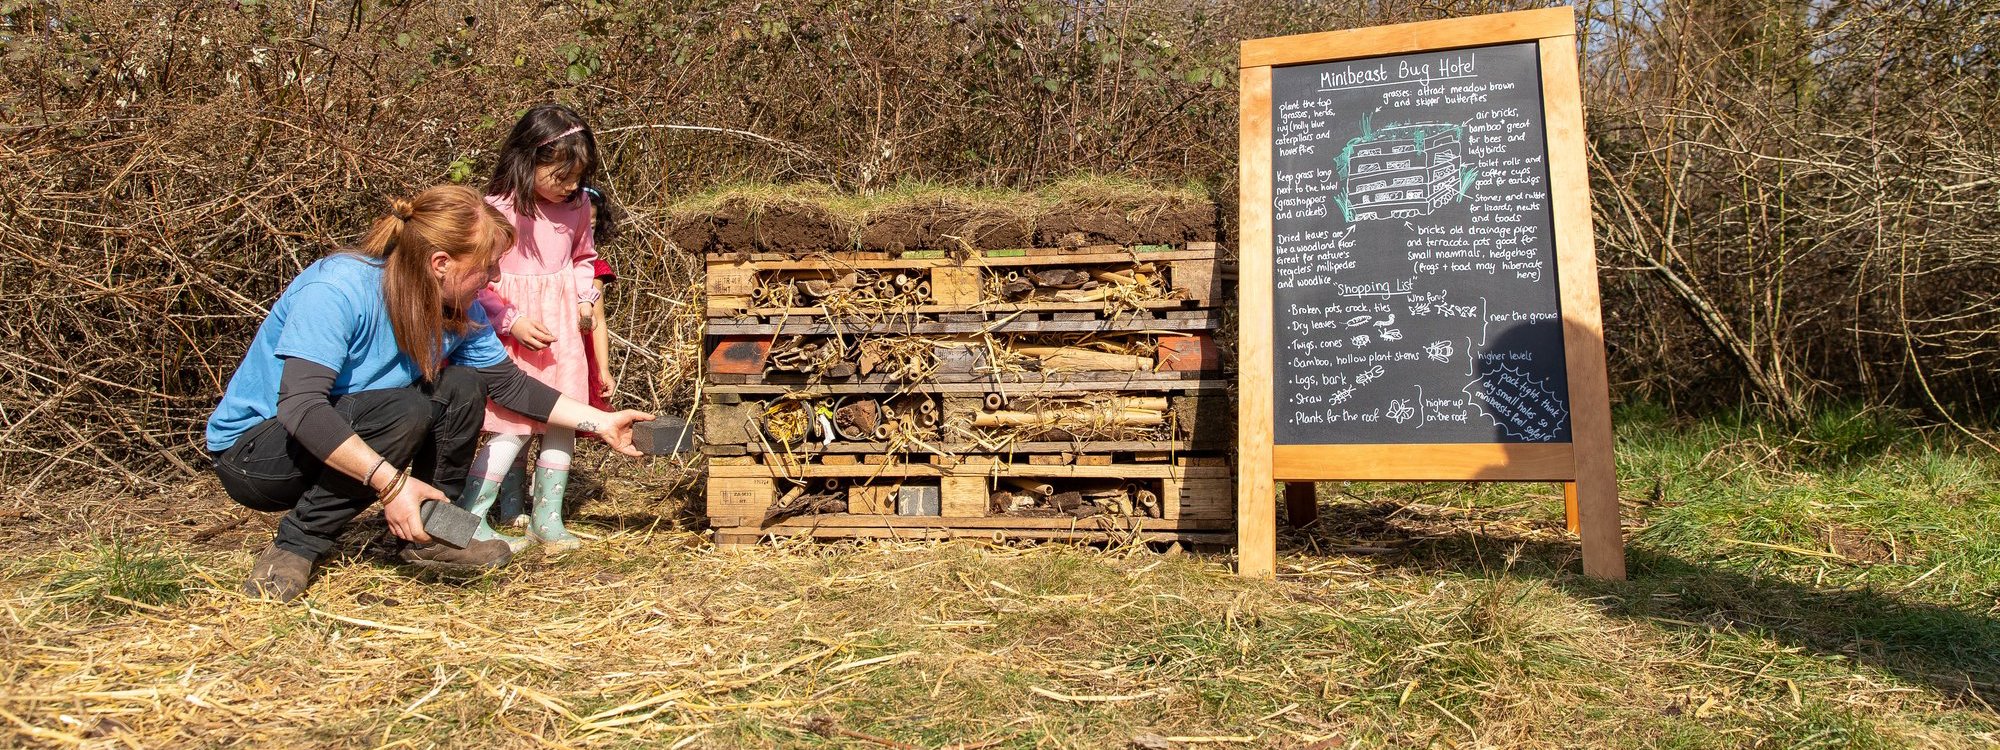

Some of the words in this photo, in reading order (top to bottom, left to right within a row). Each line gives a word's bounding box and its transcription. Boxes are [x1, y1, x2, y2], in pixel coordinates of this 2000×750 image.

[1320, 63, 1388, 88] Minibeast
[1398, 60, 1430, 86] Bug
[1439, 52, 1475, 78] Hotel
[1417, 84, 1446, 97] attract
[1450, 82, 1487, 94] meadow
[1489, 81, 1515, 91] brown
[1394, 98, 1411, 108] and
[1415, 97, 1441, 107] skipper
[1444, 92, 1488, 105] butterflies
[1279, 99, 1300, 119] plant
[1302, 99, 1316, 109] the
[1316, 97, 1332, 110] top
[1476, 110, 1490, 120] air
[1491, 107, 1519, 119] bricks,
[1277, 123, 1289, 136] ivy
[1311, 120, 1325, 129] blue
[1506, 118, 1531, 133] great
[1275, 133, 1314, 146] caterpillars
[1315, 130, 1331, 140] and
[1468, 135, 1480, 146] for
[1484, 134, 1503, 144] bees
[1507, 131, 1526, 142] and
[1478, 158, 1500, 168] toilet
[1502, 156, 1521, 167] rolls
[1525, 155, 1542, 164] and
[1276, 170, 1294, 185] Keep
[1295, 170, 1315, 185] grass
[1316, 167, 1333, 183] long
[1481, 168, 1507, 178] coffee
[1510, 167, 1532, 178] cups
[1276, 184, 1293, 195] next
[1294, 184, 1304, 194] to
[1305, 182, 1319, 193] the
[1320, 181, 1338, 191] hotel
[1475, 179, 1493, 191] good
[1495, 177, 1506, 187] for
[1508, 175, 1541, 187] earwigs
[1474, 193, 1502, 202] Stones
[1505, 190, 1524, 201] and
[1275, 209, 1293, 221] and
[1469, 203, 1482, 214] for
[1484, 203, 1513, 213] lizards,
[1516, 203, 1541, 211] newts
[1471, 213, 1490, 223] and
[1494, 213, 1522, 223] toads
[1278, 231, 1301, 244] Dried
[1305, 230, 1329, 241] leaves
[1332, 230, 1343, 239] are
[1449, 225, 1464, 234] old
[1468, 223, 1511, 238] drainage
[1513, 225, 1538, 236] pipes
[1276, 245, 1288, 255] like
[1296, 239, 1336, 252] woodland
[1406, 238, 1423, 247] and
[1426, 236, 1470, 247] terracota
[1473, 237, 1491, 257] pots
[1495, 236, 1517, 249] good
[1520, 235, 1538, 246] for
[1407, 248, 1431, 261] small
[1435, 248, 1485, 259] mammals,
[1489, 246, 1538, 260] hedgehogs
[1276, 253, 1300, 265] Great
[1303, 252, 1315, 264] for
[1317, 250, 1350, 261] nature's
[1316, 260, 1357, 274] millipedes
[1450, 261, 1472, 272] toad
[1475, 262, 1496, 275] may
[1501, 259, 1543, 270] hibernate
[1516, 267, 1541, 282] here)
[1277, 279, 1294, 289] and
[1297, 274, 1332, 287] woodlice
[1407, 294, 1425, 302] Who
[1291, 303, 1322, 316] Broken
[1374, 301, 1391, 312] tiles
[1490, 312, 1510, 322] near
[1512, 310, 1527, 321] the
[1293, 321, 1309, 336] Dry
[1311, 320, 1337, 329] leaves
[1320, 339, 1343, 348] cones
[1336, 354, 1367, 365] hollow
[1368, 351, 1393, 366] plant
[1394, 350, 1420, 361] stems
[1477, 350, 1506, 365] higher
[1509, 350, 1532, 361] levels
[1295, 374, 1319, 390] Logs,
[1322, 372, 1347, 386] bark
[1295, 392, 1322, 405] Straw
[1498, 372, 1519, 388] pack
[1540, 399, 1560, 418] think
[1425, 398, 1451, 413] higher
[1452, 398, 1464, 409] up
[1475, 390, 1512, 417] minibeasts
[1510, 412, 1528, 428] feel
[1483, 379, 1496, 396] dry
[1495, 388, 1520, 406] small
[1517, 401, 1537, 420] holes
[1538, 418, 1549, 428] so
[1295, 410, 1324, 426] Plants
[1326, 409, 1341, 424] for
[1342, 409, 1359, 421] the
[1361, 407, 1380, 422] roof
[1426, 414, 1437, 422] on
[1437, 411, 1450, 422] the
[1451, 409, 1468, 424] roof
